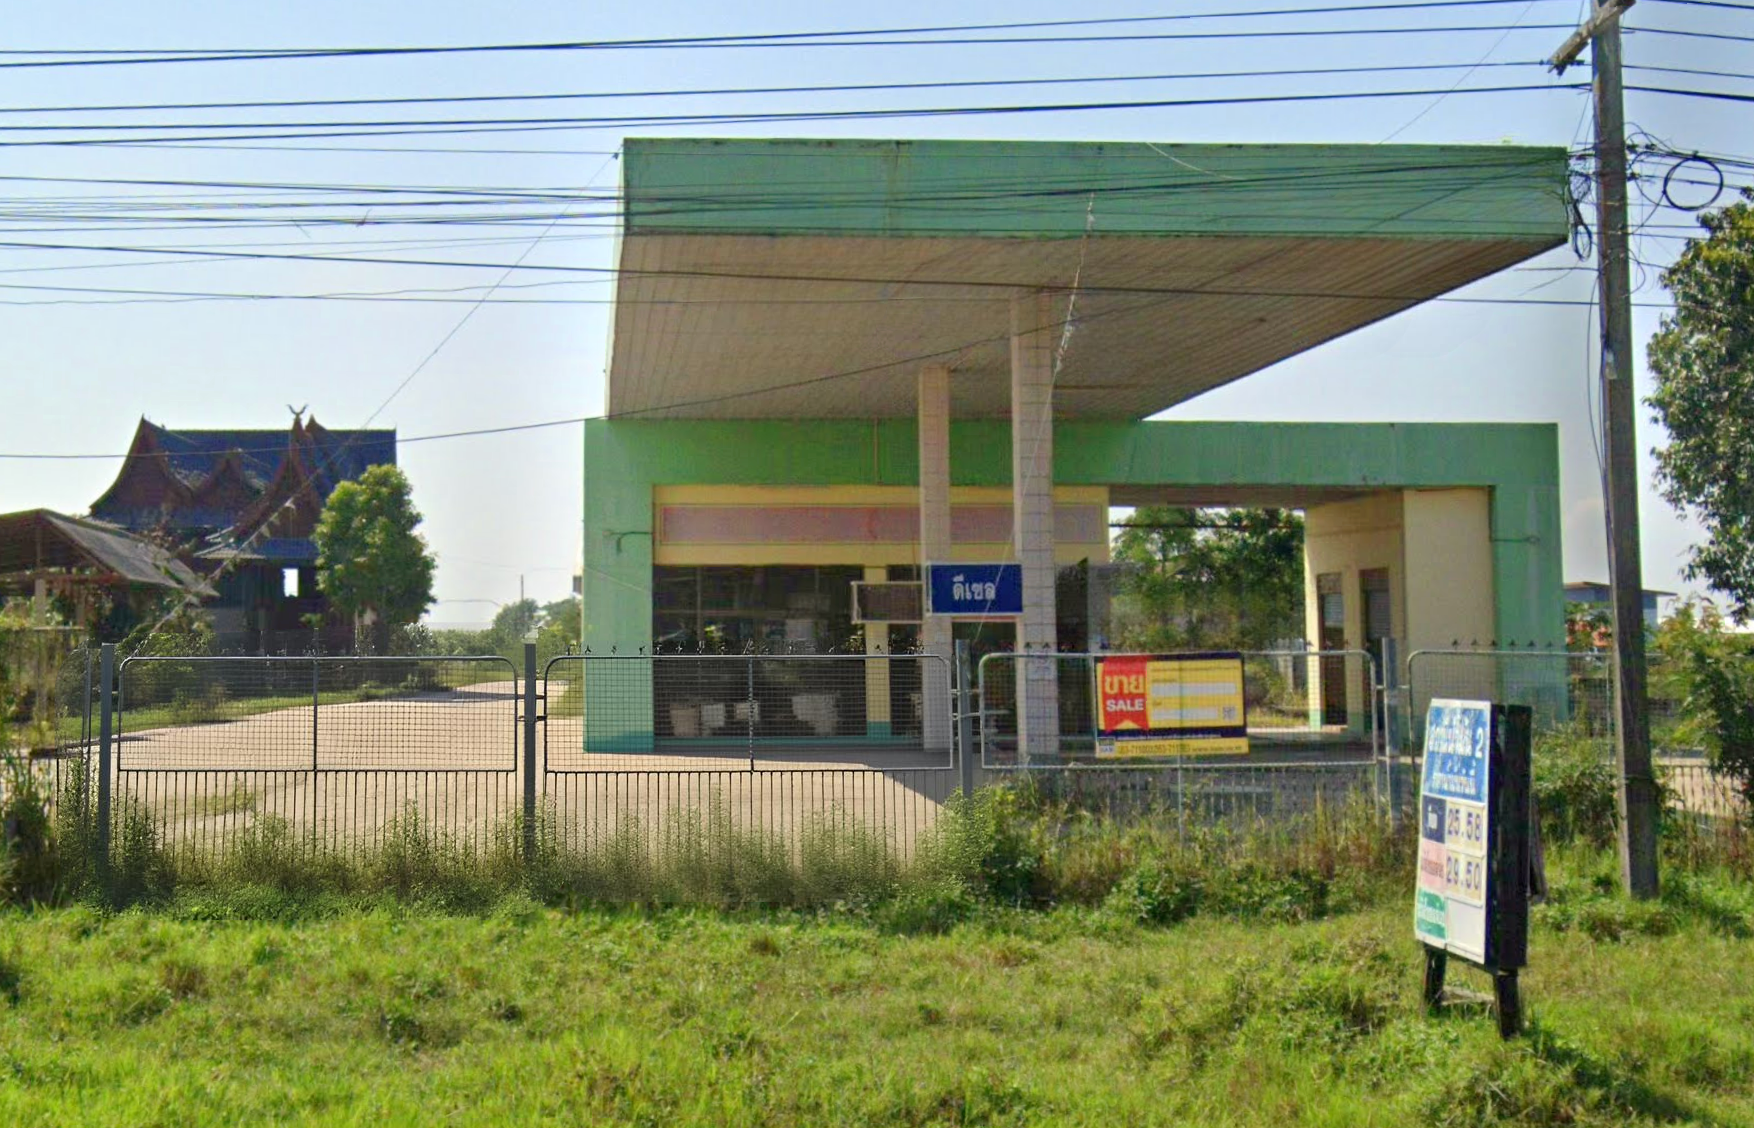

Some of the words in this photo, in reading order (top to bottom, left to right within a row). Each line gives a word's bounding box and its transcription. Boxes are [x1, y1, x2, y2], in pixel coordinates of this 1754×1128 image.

[953, 574, 996, 601] ดีเซล
[1105, 674, 1145, 695] ขาย
[1106, 699, 1144, 712] SALE
[1475, 726, 1484, 759] 2
